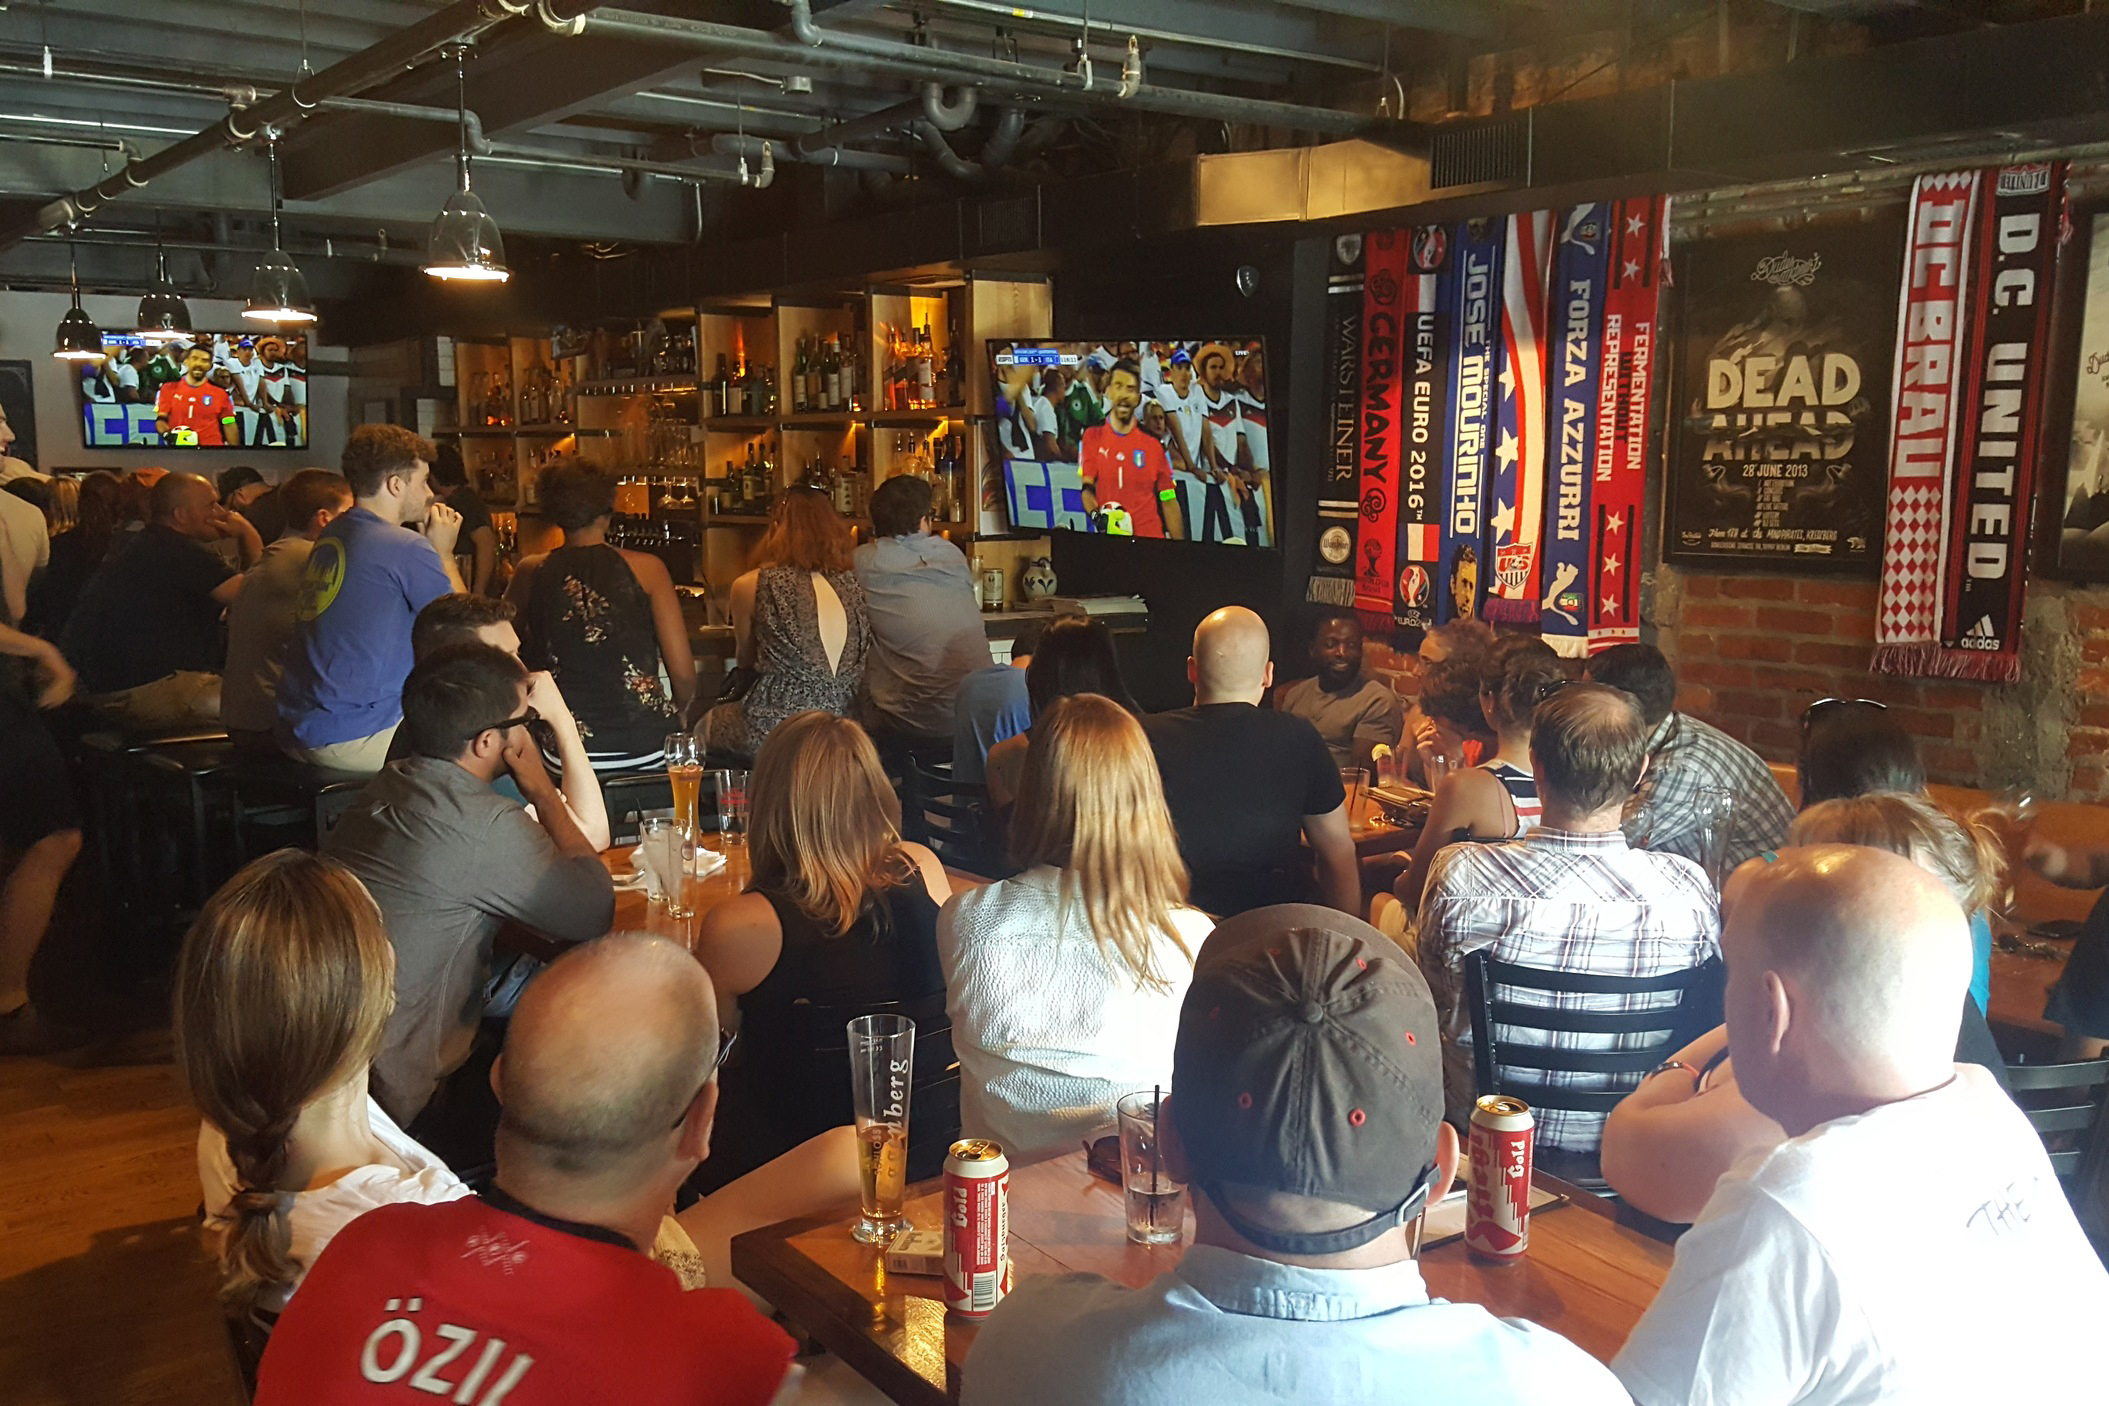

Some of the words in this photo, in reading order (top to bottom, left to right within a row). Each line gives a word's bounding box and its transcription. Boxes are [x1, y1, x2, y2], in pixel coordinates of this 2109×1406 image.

[1913, 199, 1966, 289] DC
[1992, 213, 2041, 315] D.C.
[1415, 315, 1435, 375] UEFA
[1464, 253, 1489, 348] JOSE
[1564, 279, 1592, 387] FORZA
[1335, 315, 1357, 482] WARSTEINER
[1363, 312, 1396, 484] GERMANY
[1412, 381, 1431, 444] EURO
[1481, 367, 1490, 420] SPECIAL
[1596, 314, 1622, 482] REPRESENTATION
[1615, 351, 1633, 443] WITHOUT
[1626, 322, 1650, 470] FERMENTATION
[1706, 352, 1861, 410] DEAD
[1894, 299, 1955, 479] BRAU
[1455, 354, 1484, 534] MOURINHO
[1557, 398, 1585, 541] AZZURRI
[1702, 411, 1855, 461] AHEAD
[1743, 464, 1755, 477] 28
[1756, 464, 1782, 477] JUNE
[1785, 464, 1808, 477] 2013
[1967, 342, 2028, 579] UNITED
[1961, 636, 2000, 650] adidas
[1507, 1140, 1526, 1179] Gold
[950, 1186, 968, 1229] Gold
